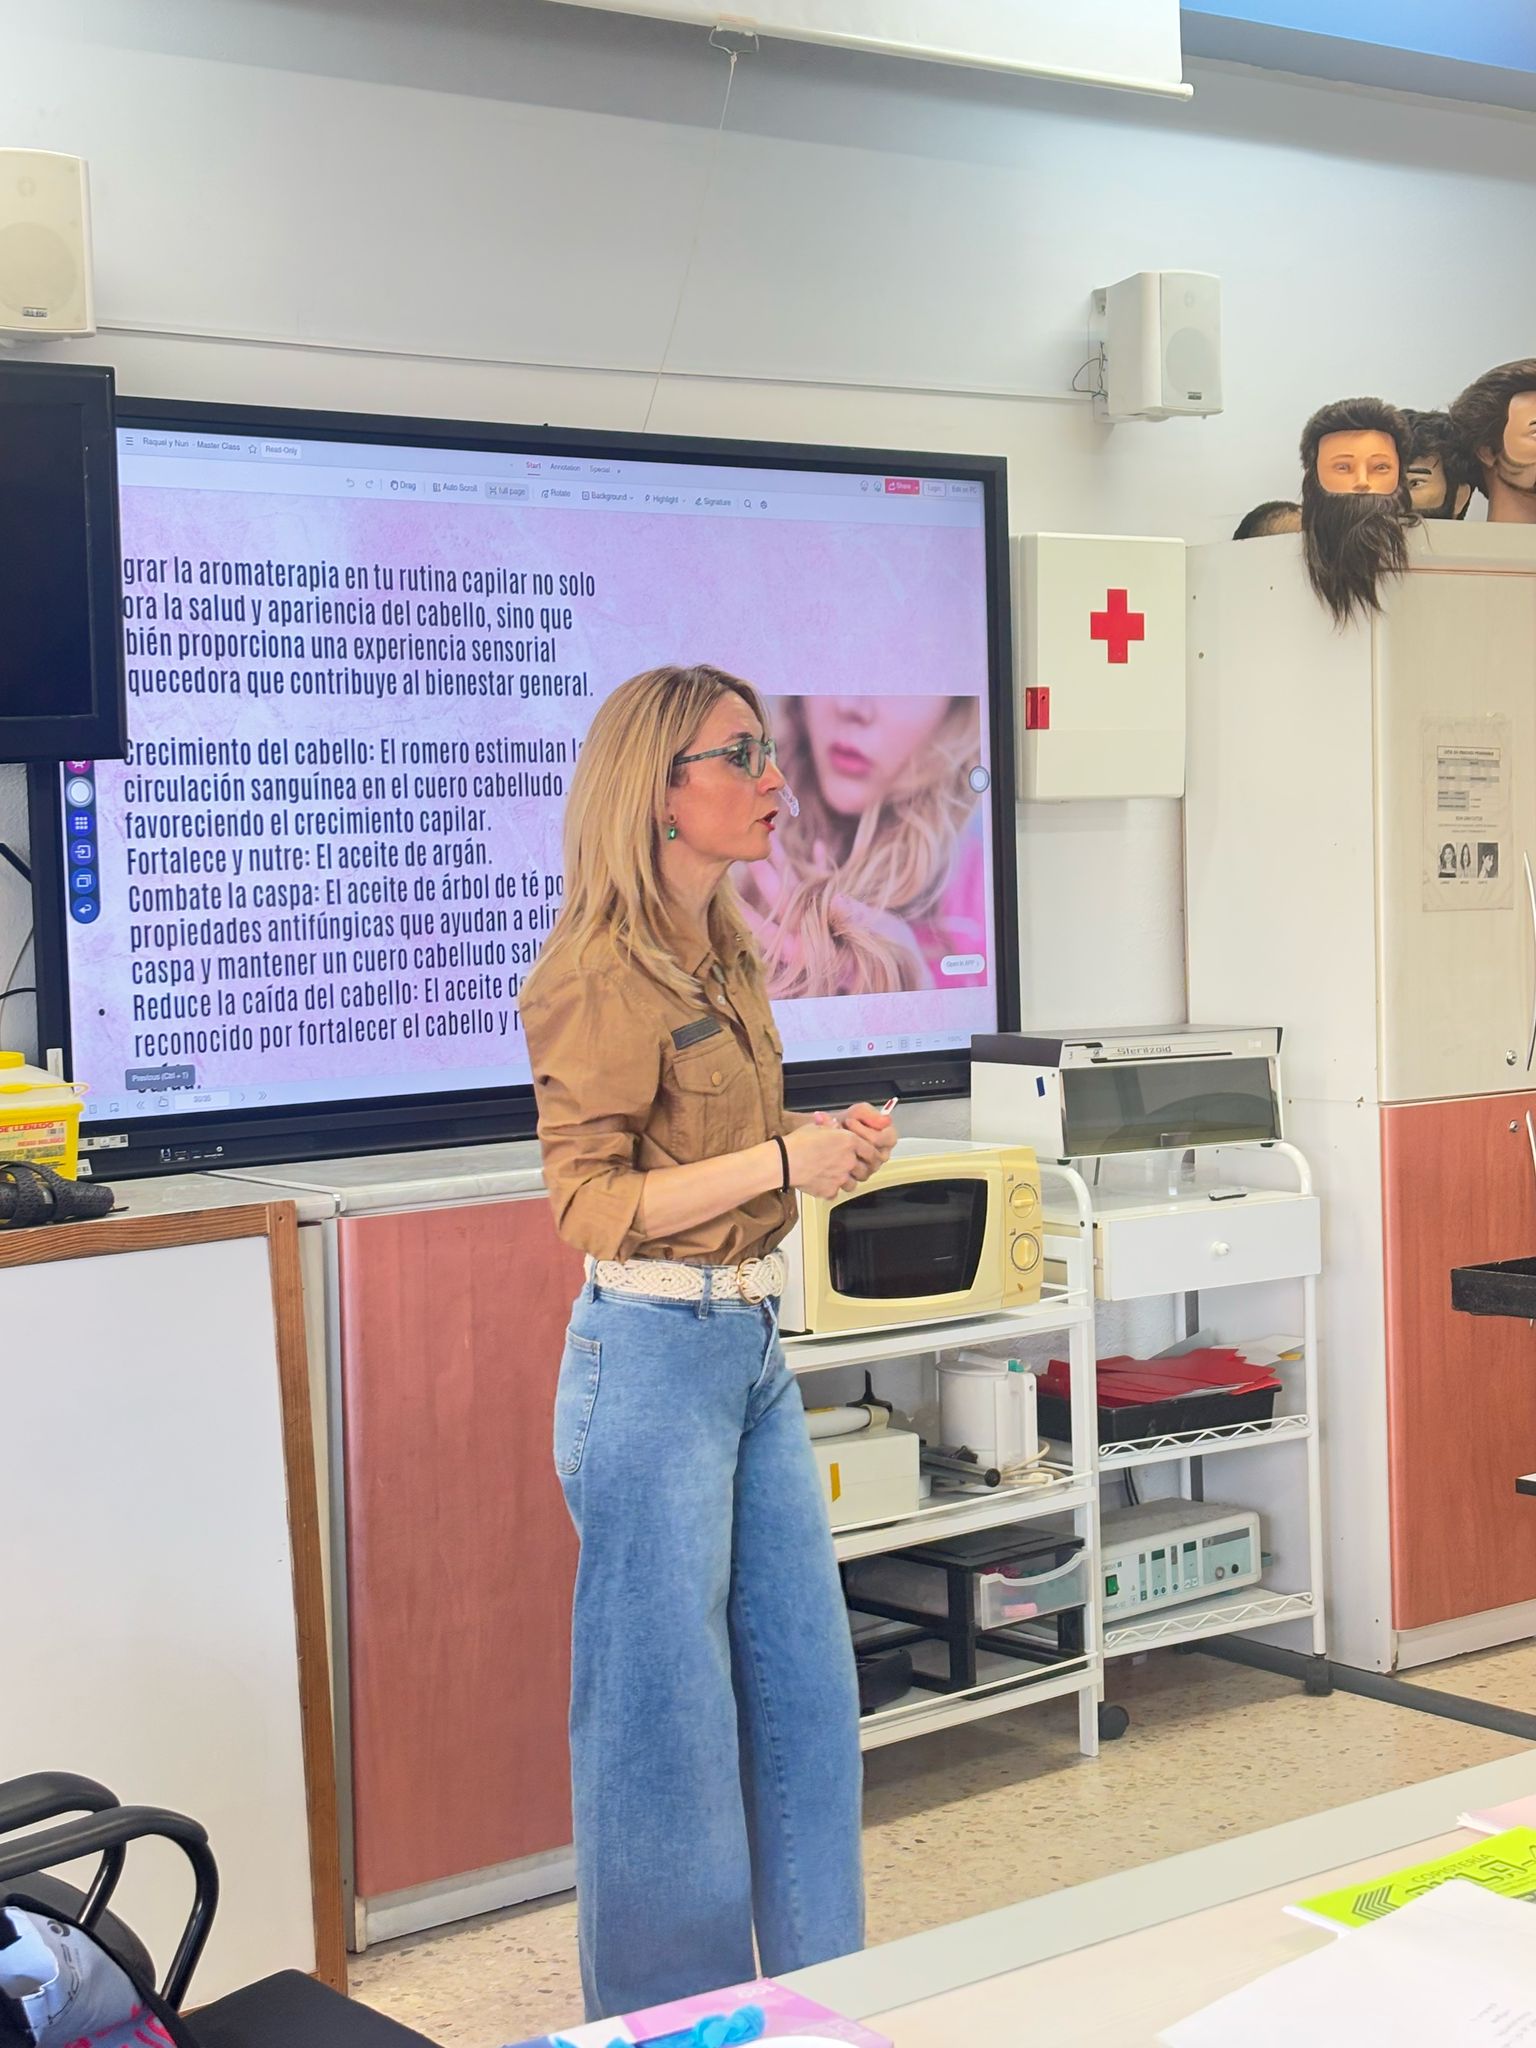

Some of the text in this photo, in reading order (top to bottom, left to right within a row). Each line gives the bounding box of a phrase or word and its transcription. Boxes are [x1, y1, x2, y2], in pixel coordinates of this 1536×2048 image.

[196, 440, 220, 450] Master
[221, 442, 240, 451] Class
[526, 461, 541, 469] Start
[400, 480, 416, 491] Drag
[442, 483, 478, 492] Auto Scroll
[550, 488, 571, 498] Rotate
[591, 491, 628, 502] Background
[124, 556, 595, 598] grar la aromaterapia en tu rutina capilar no solo
[164, 592, 182, 620] la
[189, 594, 246, 622] salud
[251, 598, 262, 626] y
[268, 596, 376, 627] apariencia
[382, 599, 411, 626] del
[417, 600, 491, 632] cabello,
[496, 602, 534, 630] sino
[540, 607, 572, 634] que
[126, 626, 556, 664] bién proporciona una experiencia sensorial
[128, 666, 594, 699] quecedora que contribuye al bienestar general.
[258, 738, 288, 766] del
[294, 738, 374, 765] cabello:
[380, 738, 395, 764] El
[402, 741, 469, 764] romero
[475, 737, 566, 764] estimulan
[124, 772, 245, 803] circulación
[250, 771, 356, 804] sanguínea
[362, 776, 386, 800] en
[392, 773, 408, 800] el
[414, 776, 468, 799] cuero
[125, 805, 492, 839] favoreciendo el crecimiento capilar.
[127, 837, 493, 876] Fortalece y nutre: El aceite de argán.
[128, 882, 222, 913] Combate
[228, 881, 246, 909] la
[253, 883, 320, 910] caspa:
[326, 879, 341, 906] El
[348, 875, 408, 904] aceite
[414, 876, 436, 903] de
[442, 873, 490, 902] árbol
[495, 874, 516, 899] de
[522, 871, 539, 898] té
[130, 917, 262, 953] propiedades
[268, 911, 394, 943] antifúngicas
[400, 912, 434, 940] que
[440, 908, 508, 938] ayudan
[513, 909, 523, 931] a
[132, 938, 542, 986] caspa y mantener un cuero cabelludo sal
[134, 992, 212, 1022] Reduce
[218, 990, 236, 1016] la
[242, 984, 298, 1014] caída
[304, 984, 334, 1010] del
[340, 980, 418, 1008] cabello:
[424, 978, 439, 1003] El
[445, 974, 502, 1001] aceite
[135, 1024, 253, 1058] reconocido
[260, 1024, 292, 1052] por
[298, 1017, 397, 1046] fortalecer
[402, 1014, 419, 1040] el
[426, 1009, 494, 1038] cabello
[500, 1010, 508, 1036] y
[132, 1074, 160, 1082] Previous
